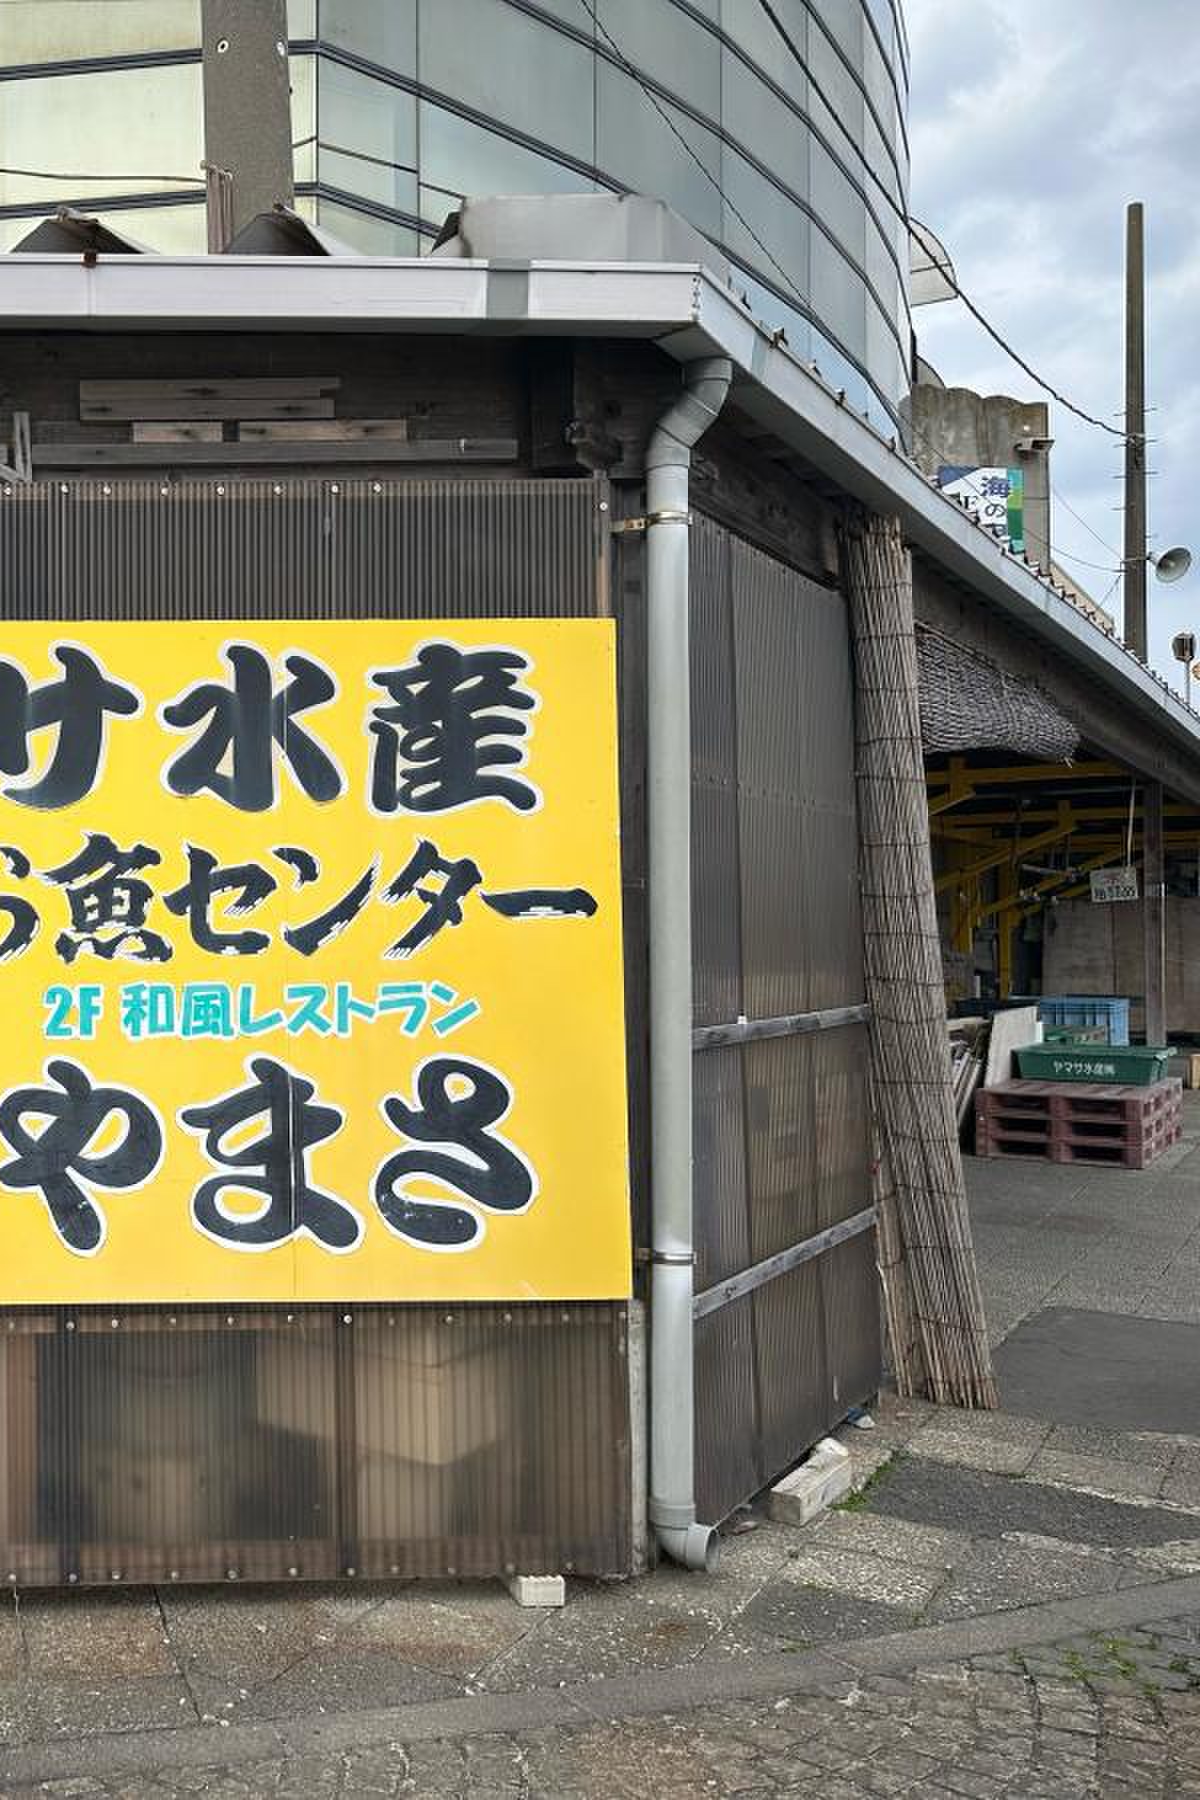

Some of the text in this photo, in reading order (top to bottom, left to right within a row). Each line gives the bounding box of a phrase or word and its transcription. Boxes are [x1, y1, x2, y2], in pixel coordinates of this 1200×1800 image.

[42, 980, 484, 1042] 2F 和風レストラン
